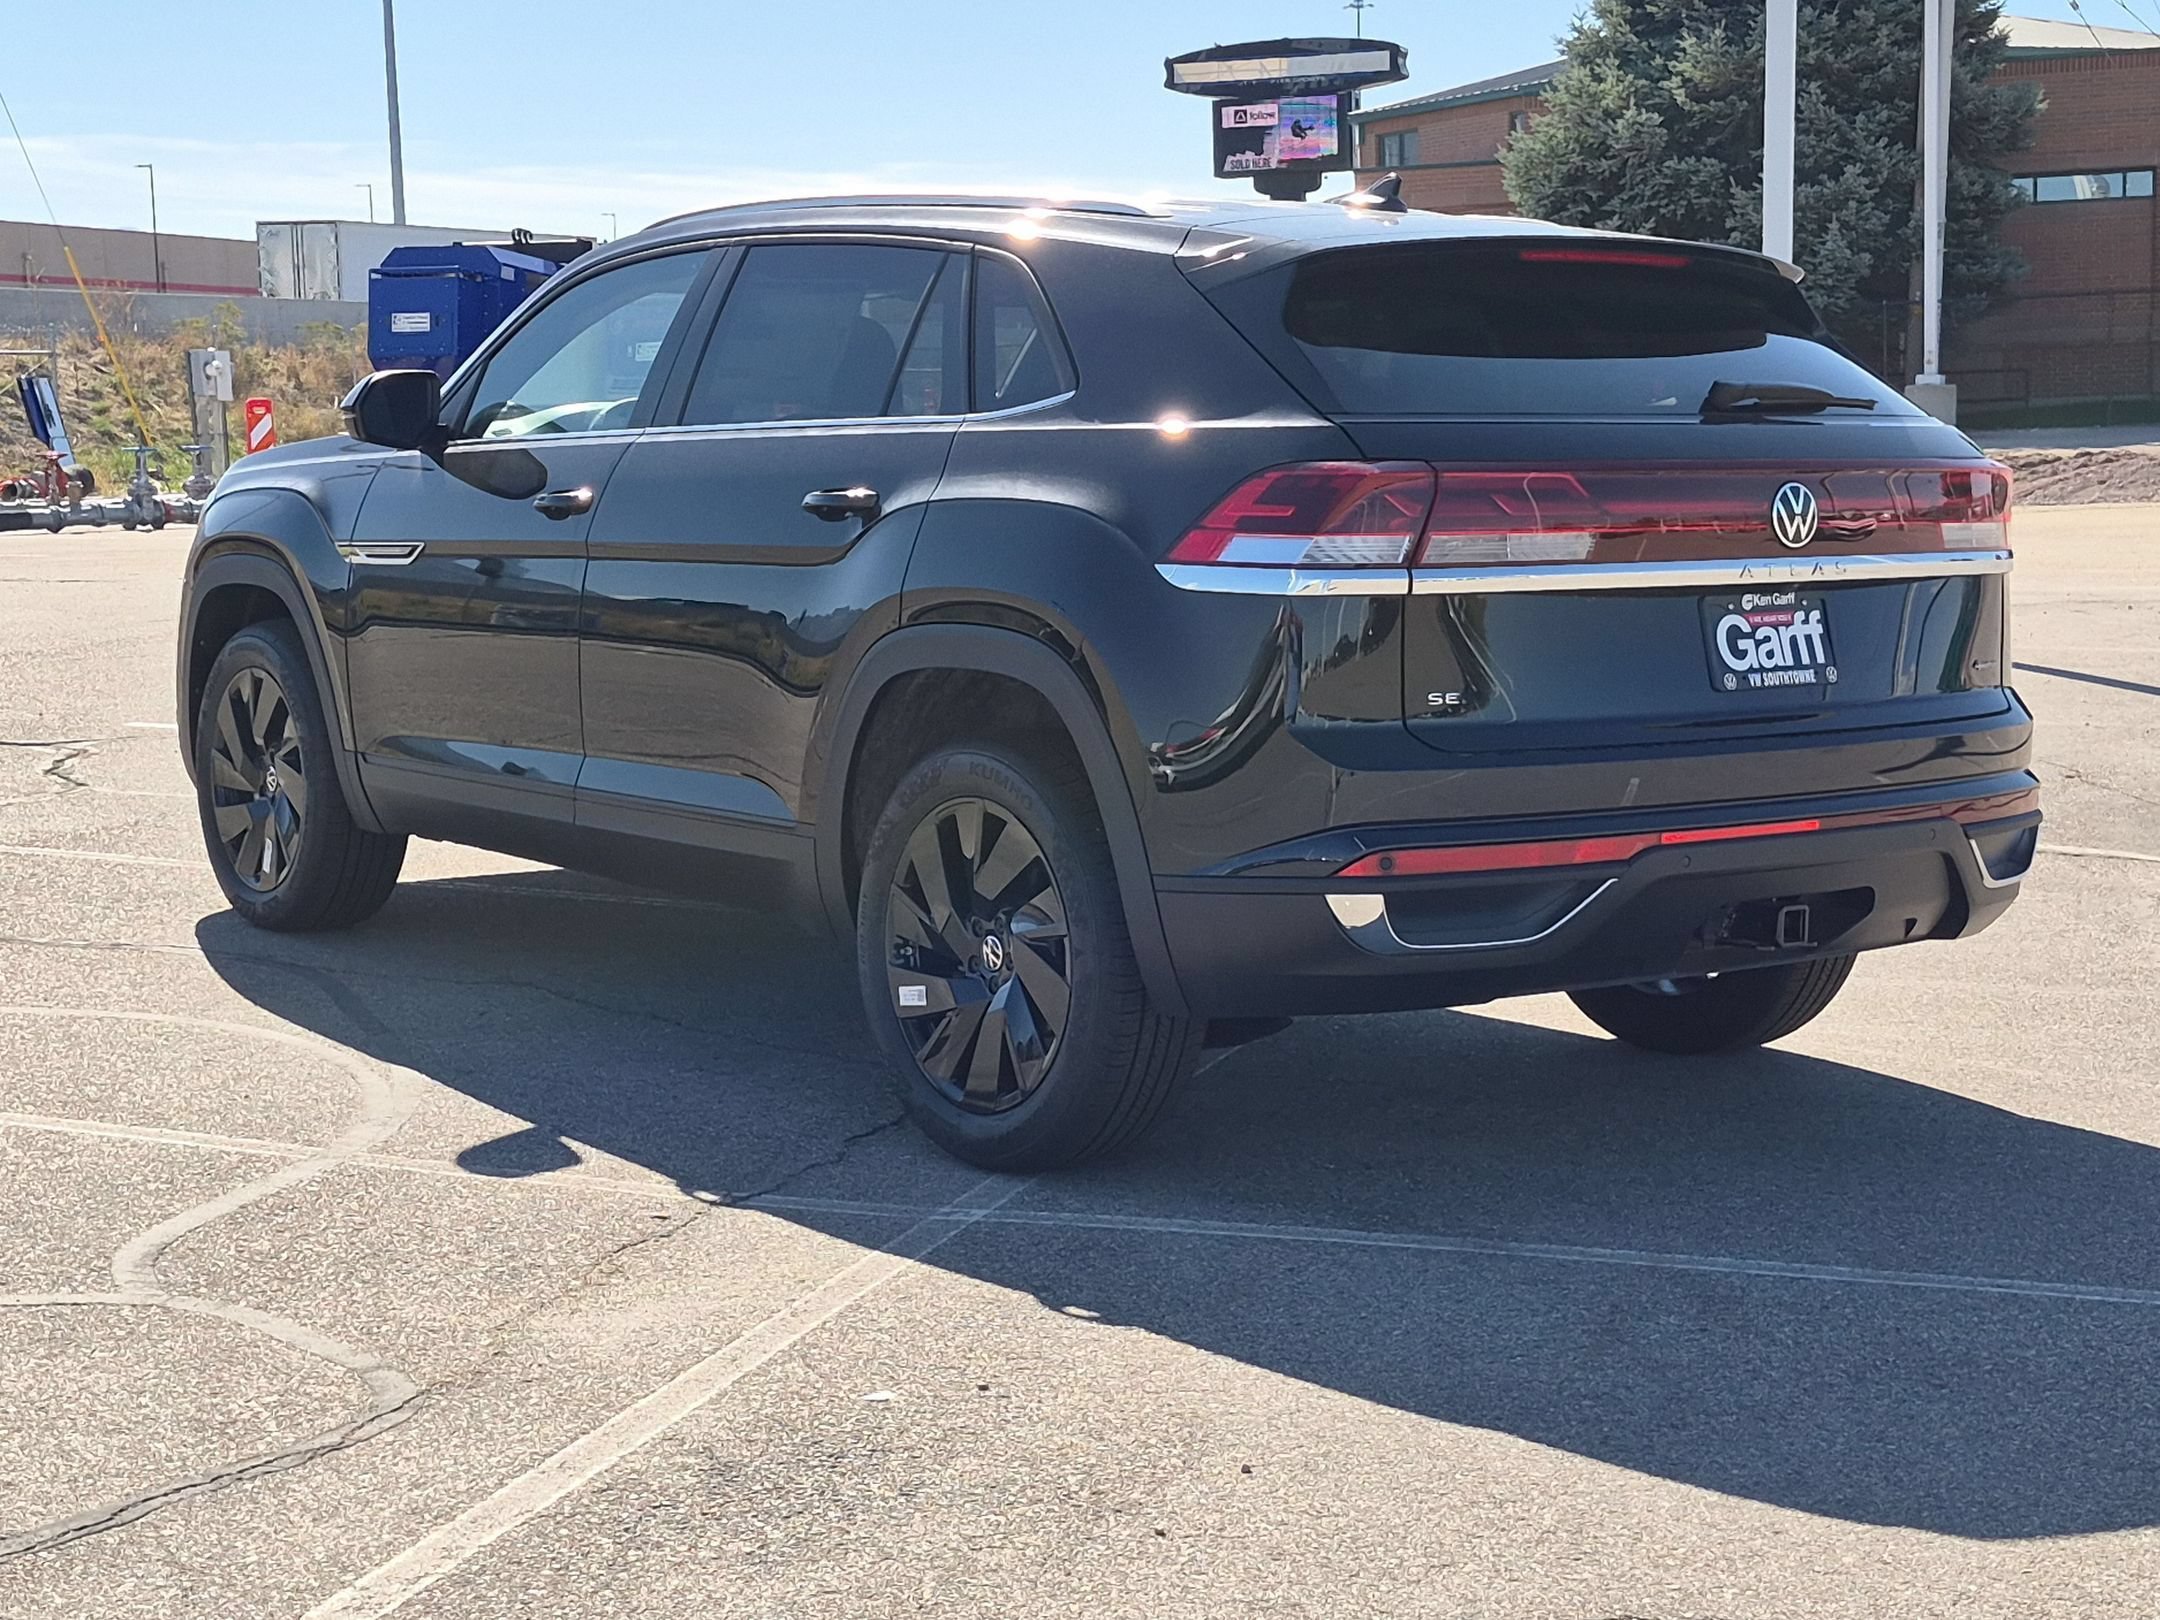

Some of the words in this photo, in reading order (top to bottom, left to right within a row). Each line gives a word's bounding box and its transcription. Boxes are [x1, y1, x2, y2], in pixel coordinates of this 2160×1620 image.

[1230, 159, 1250, 169] SOLD
[1739, 561, 1846, 578] ATLAS
[1753, 593, 1772, 606] Ken
[1772, 592, 1795, 605] Garff
[1716, 610, 1826, 671] Garff
[1748, 672, 1761, 687] VW
[1427, 692, 1461, 705] SE
